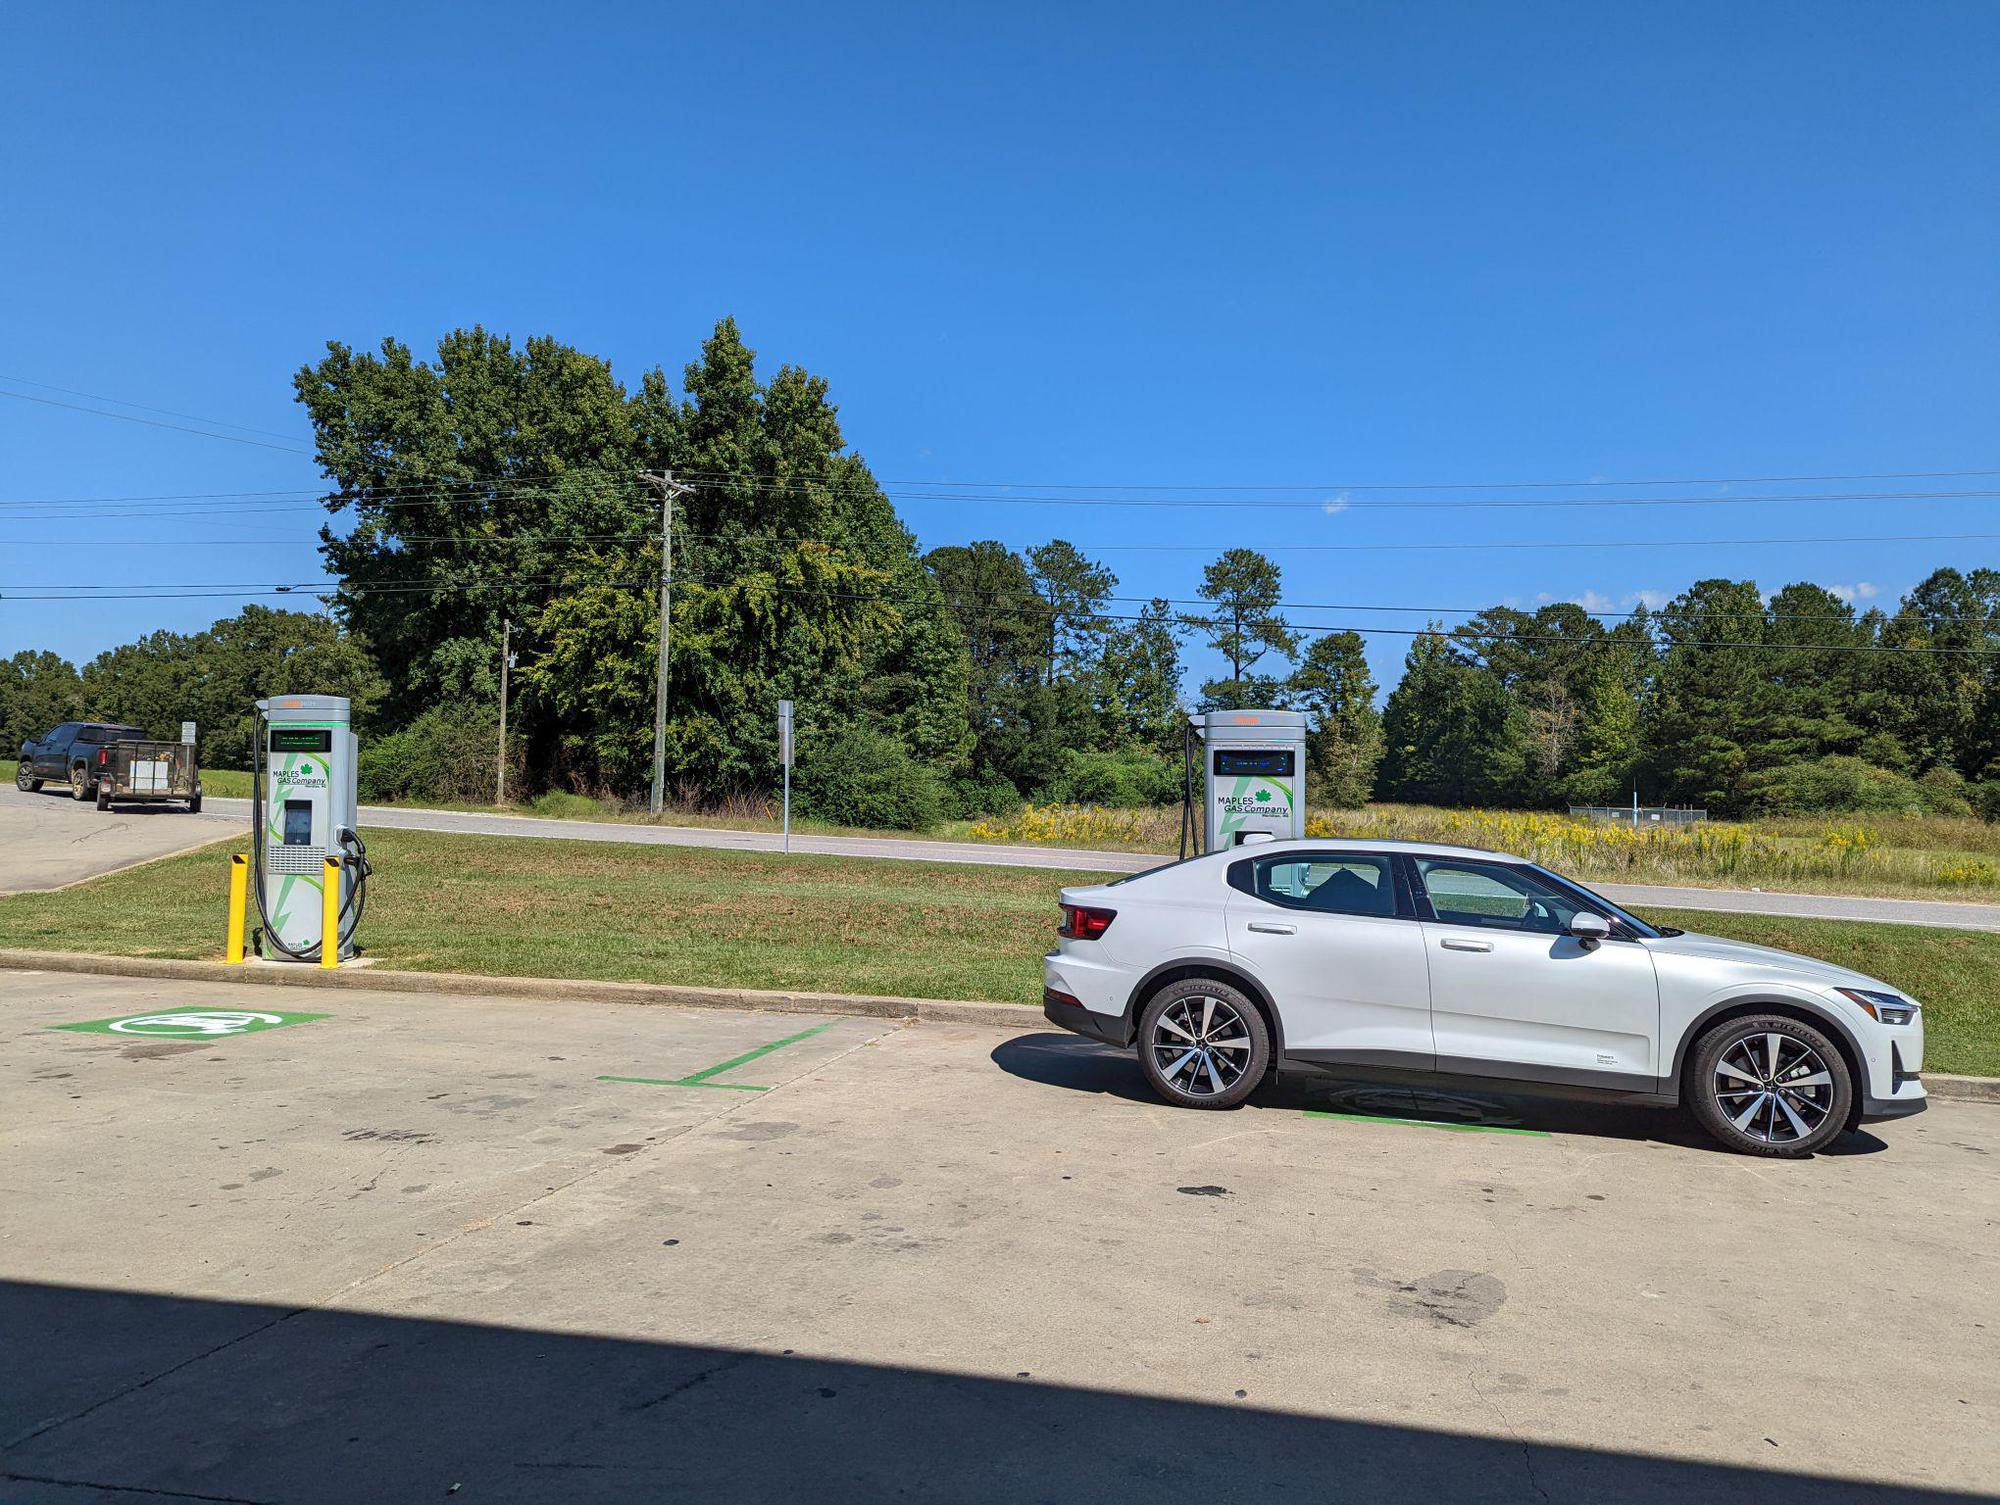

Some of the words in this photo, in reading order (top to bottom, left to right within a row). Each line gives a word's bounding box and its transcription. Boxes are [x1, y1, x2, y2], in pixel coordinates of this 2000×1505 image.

[273, 770, 300, 778] MAPLES
[277, 777, 291, 785] GAS
[292, 777, 326, 785] Company
[1218, 797, 1254, 805] MAPLES
[1244, 805, 1289, 814] Company
